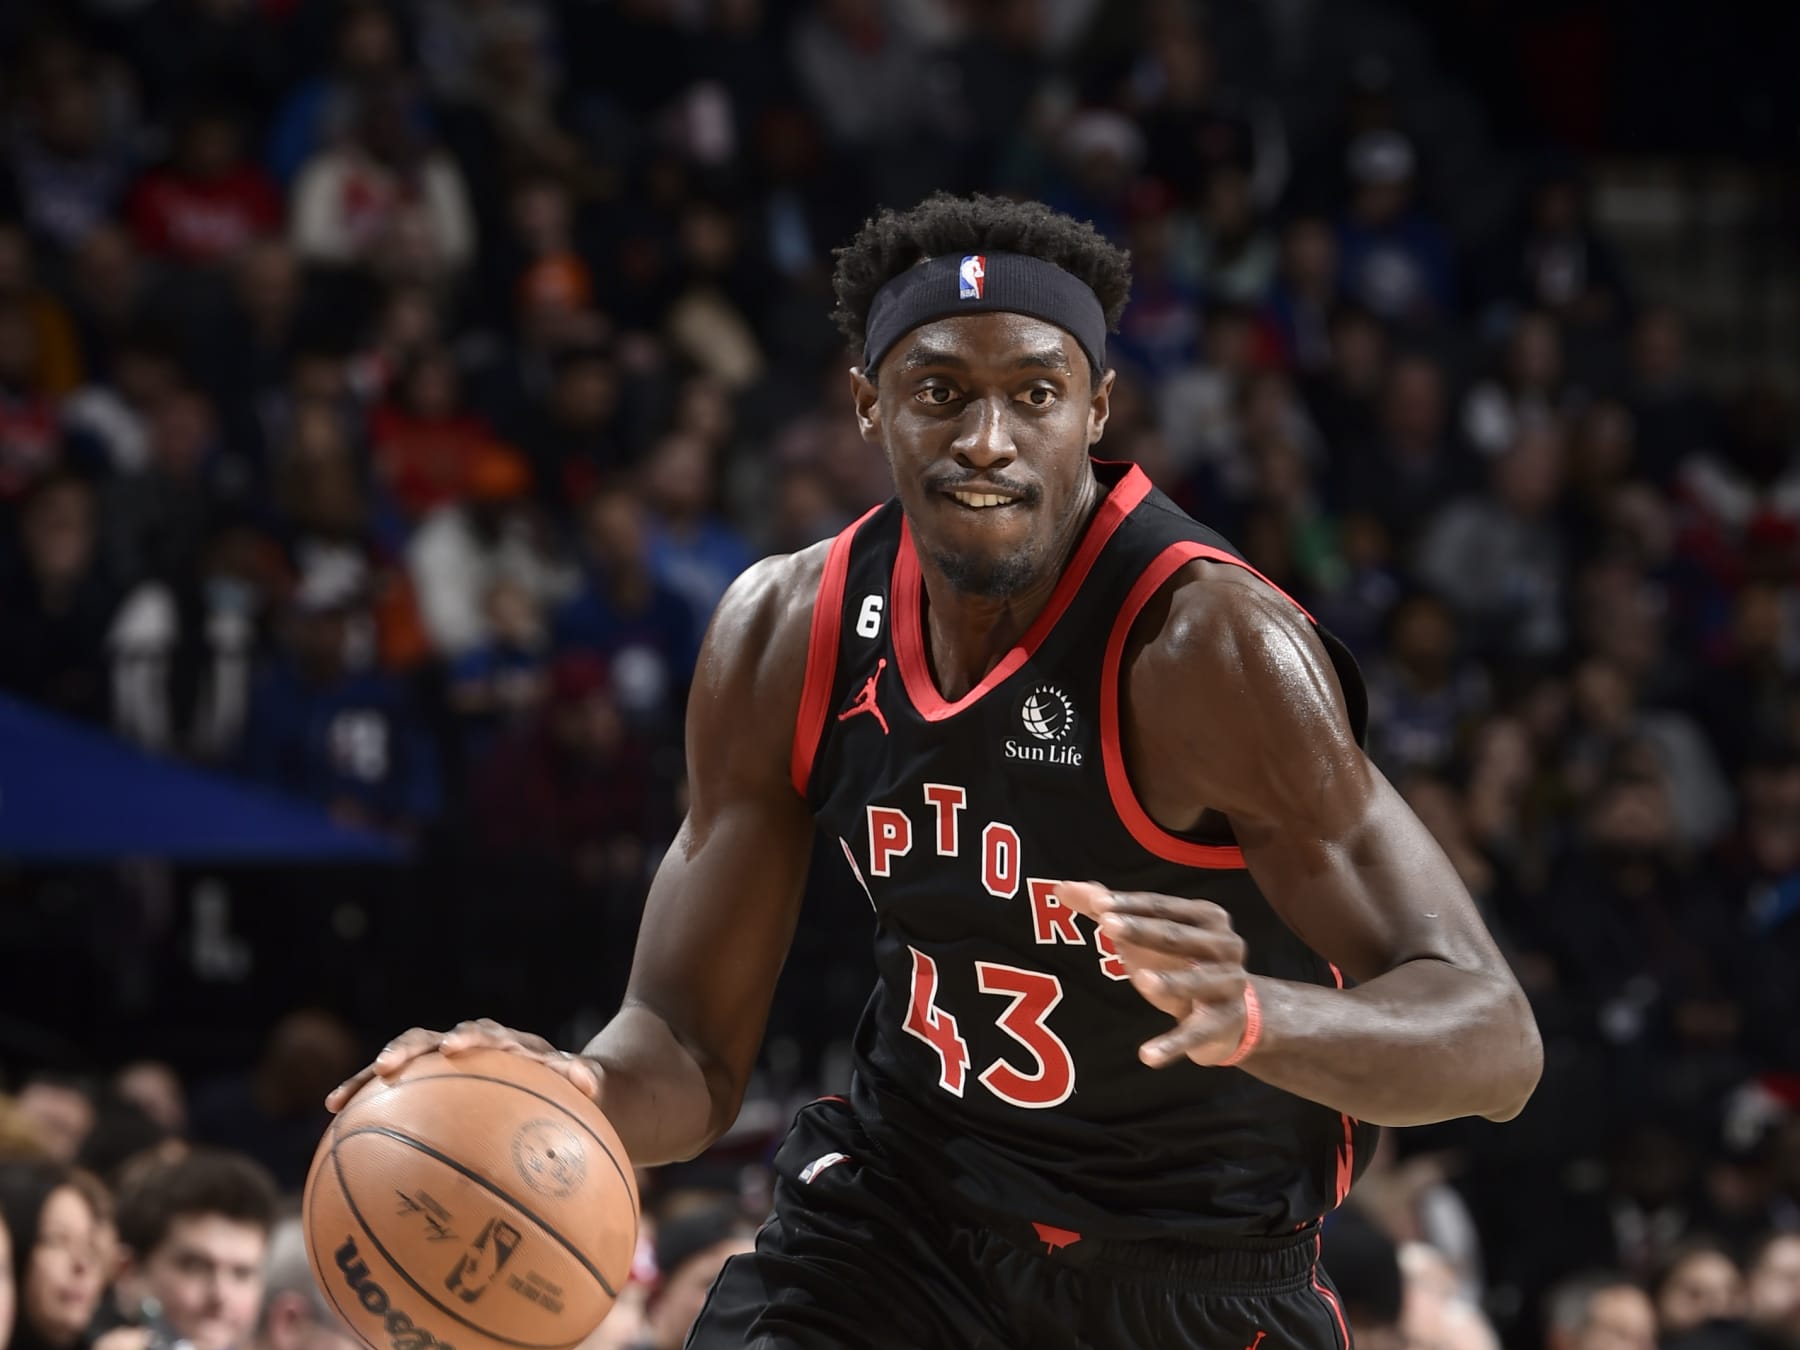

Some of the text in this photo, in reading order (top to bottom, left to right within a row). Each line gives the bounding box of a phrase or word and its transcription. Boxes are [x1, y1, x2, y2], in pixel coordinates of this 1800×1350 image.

[855, 594, 882, 639] 6
[1004, 740, 1082, 767] Sun Life
[838, 782, 1130, 981] PTOR
[901, 944, 1076, 1109] 43
